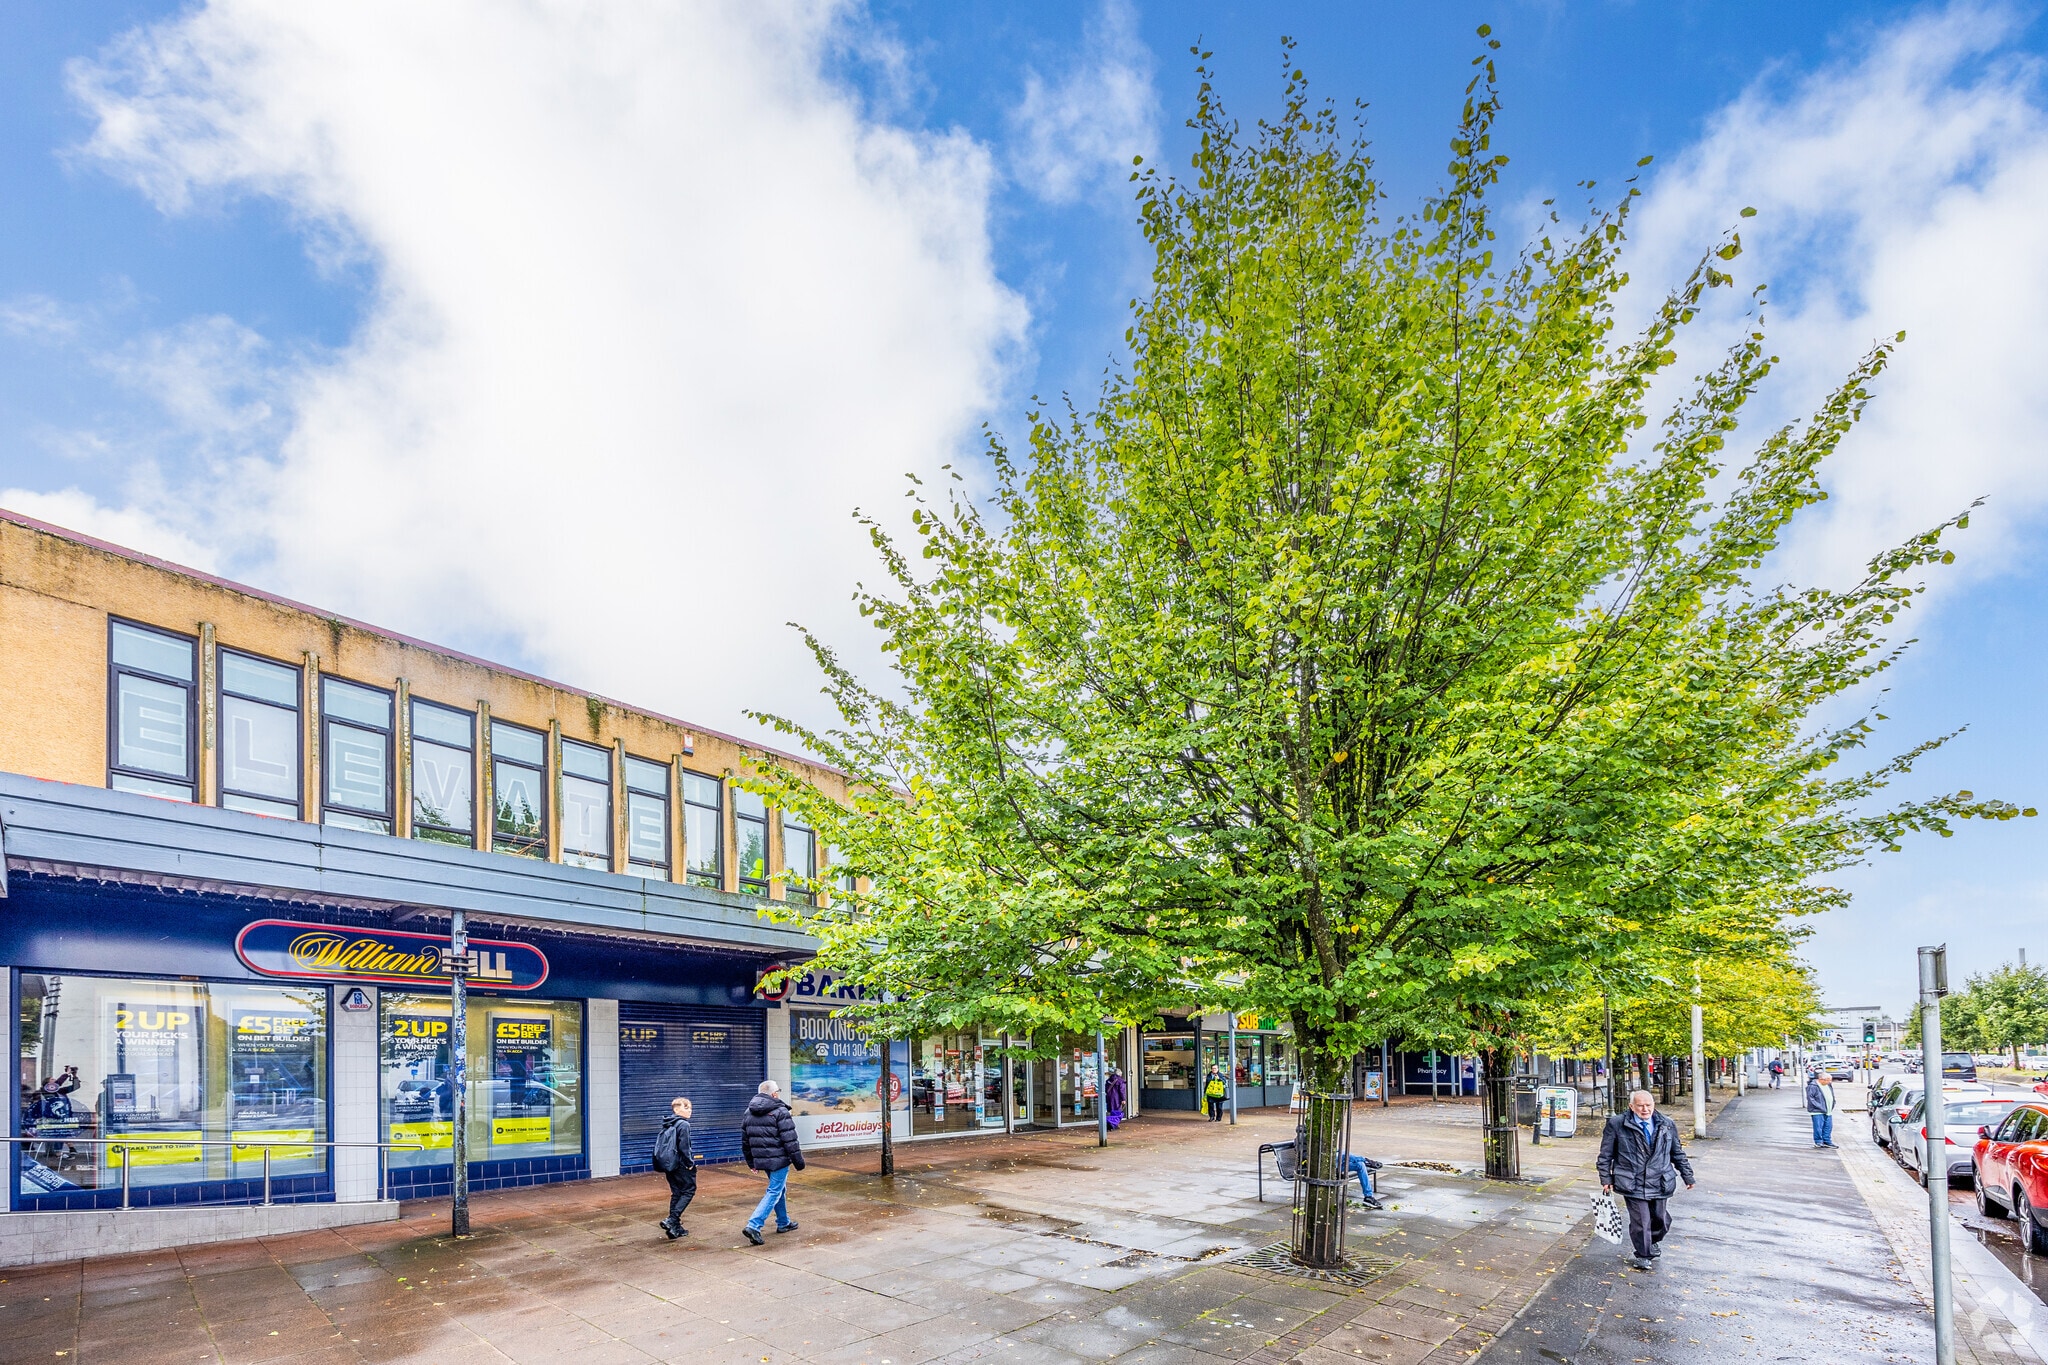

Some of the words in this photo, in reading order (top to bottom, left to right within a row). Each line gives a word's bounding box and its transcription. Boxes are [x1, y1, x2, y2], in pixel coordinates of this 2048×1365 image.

[289, 931, 441, 975] William
[114, 1010, 134, 1029] 2
[138, 1011, 190, 1030] UP
[237, 1015, 272, 1034] £5
[273, 1017, 307, 1026] FREE
[1239, 1013, 1277, 1030] SUBWA
[273, 1026, 301, 1034] BET
[394, 1020, 409, 1036] 2
[411, 1021, 448, 1037] UP
[496, 1023, 520, 1038] £5
[521, 1024, 546, 1032] FREE
[631, 1028, 657, 1042] UP
[799, 1017, 855, 1041] BOOKING
[833, 1043, 850, 1056] 0141
[852, 1042, 866, 1056] 304
[1417, 1067, 1447, 1075] Pharacy
[816, 1120, 882, 1134] jet2holidays
